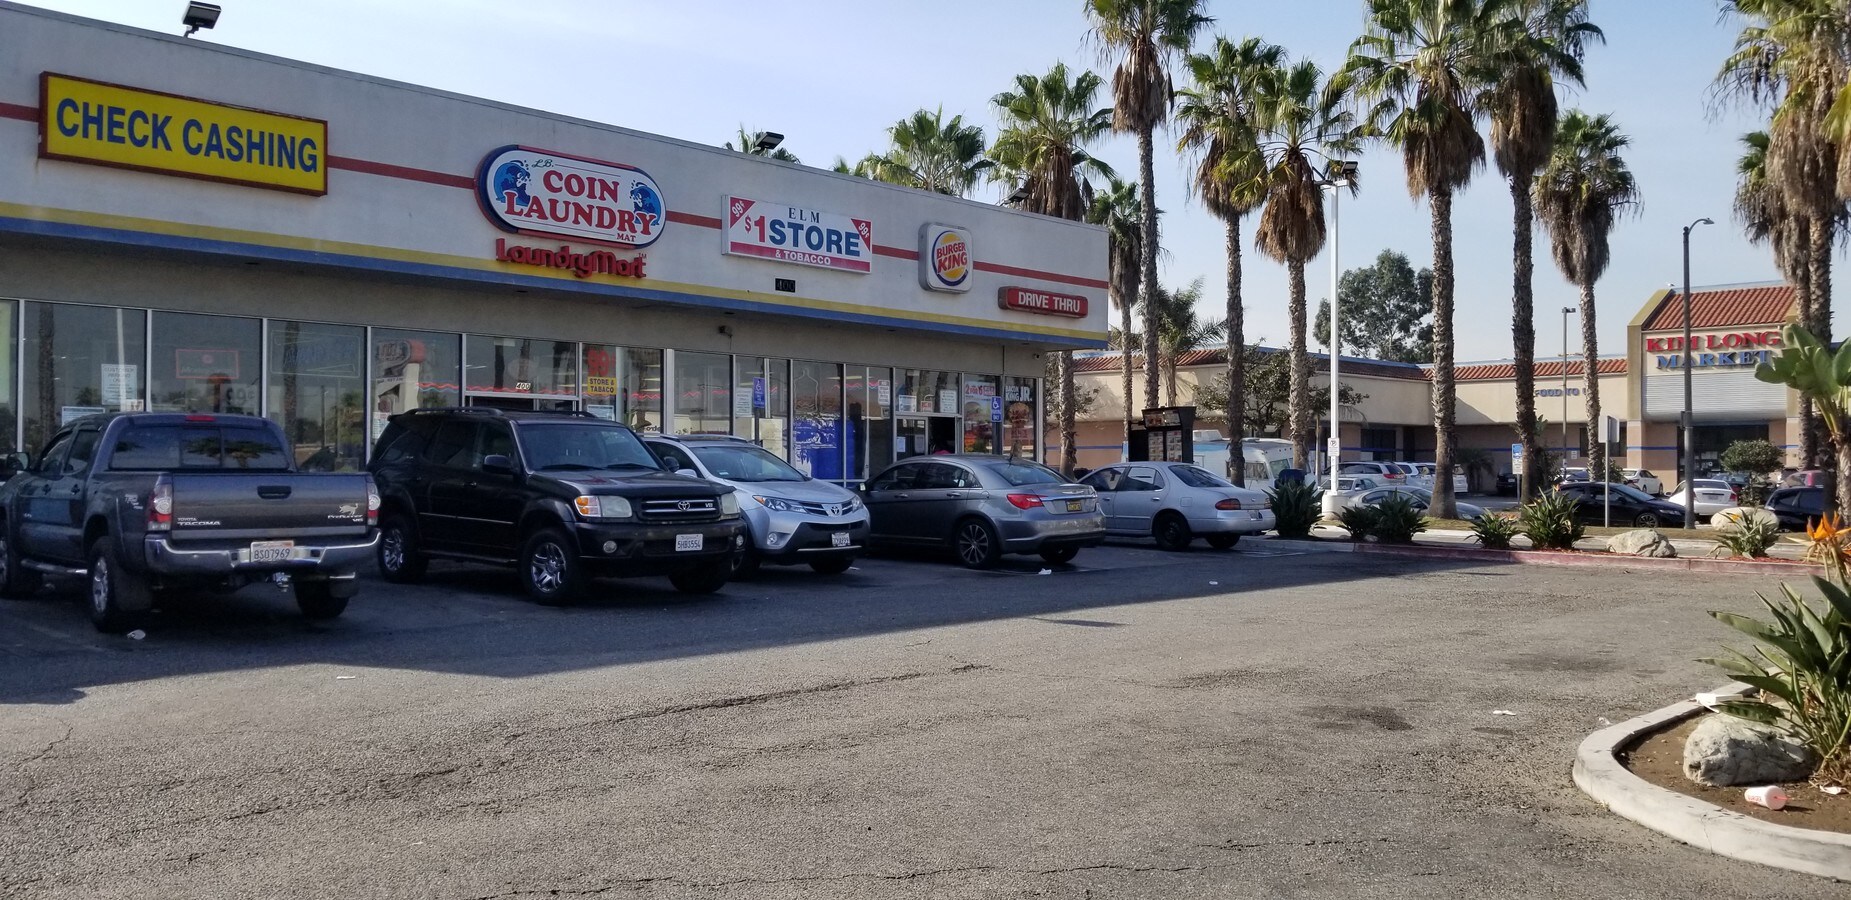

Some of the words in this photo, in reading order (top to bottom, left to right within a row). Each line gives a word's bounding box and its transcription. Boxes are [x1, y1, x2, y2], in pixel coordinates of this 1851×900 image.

[56, 98, 172, 152] CHECK
[182, 119, 317, 173] CASHING
[543, 170, 620, 203] COIN
[504, 191, 657, 235] LAUNDRY
[788, 207, 820, 223] ELM
[616, 233, 636, 243] MAT
[768, 219, 861, 257] STORE
[495, 238, 646, 278] LaundryMart
[775, 249, 781, 258] &
[783, 250, 831, 265] TOBACCO
[936, 242, 966, 259] BURGER
[937, 252, 968, 273] KING
[1018, 291, 1049, 308] DRIVE
[1053, 296, 1080, 312] THRU
[1646, 334, 1699, 352] KIM
[1705, 331, 1781, 349] LONG
[516, 382, 531, 391] 400
[589, 378, 609, 386] STORE
[591, 386, 614, 394] TABACO
[1005, 392, 1019, 401] KING
[1535, 388, 1562, 397] FOOD
